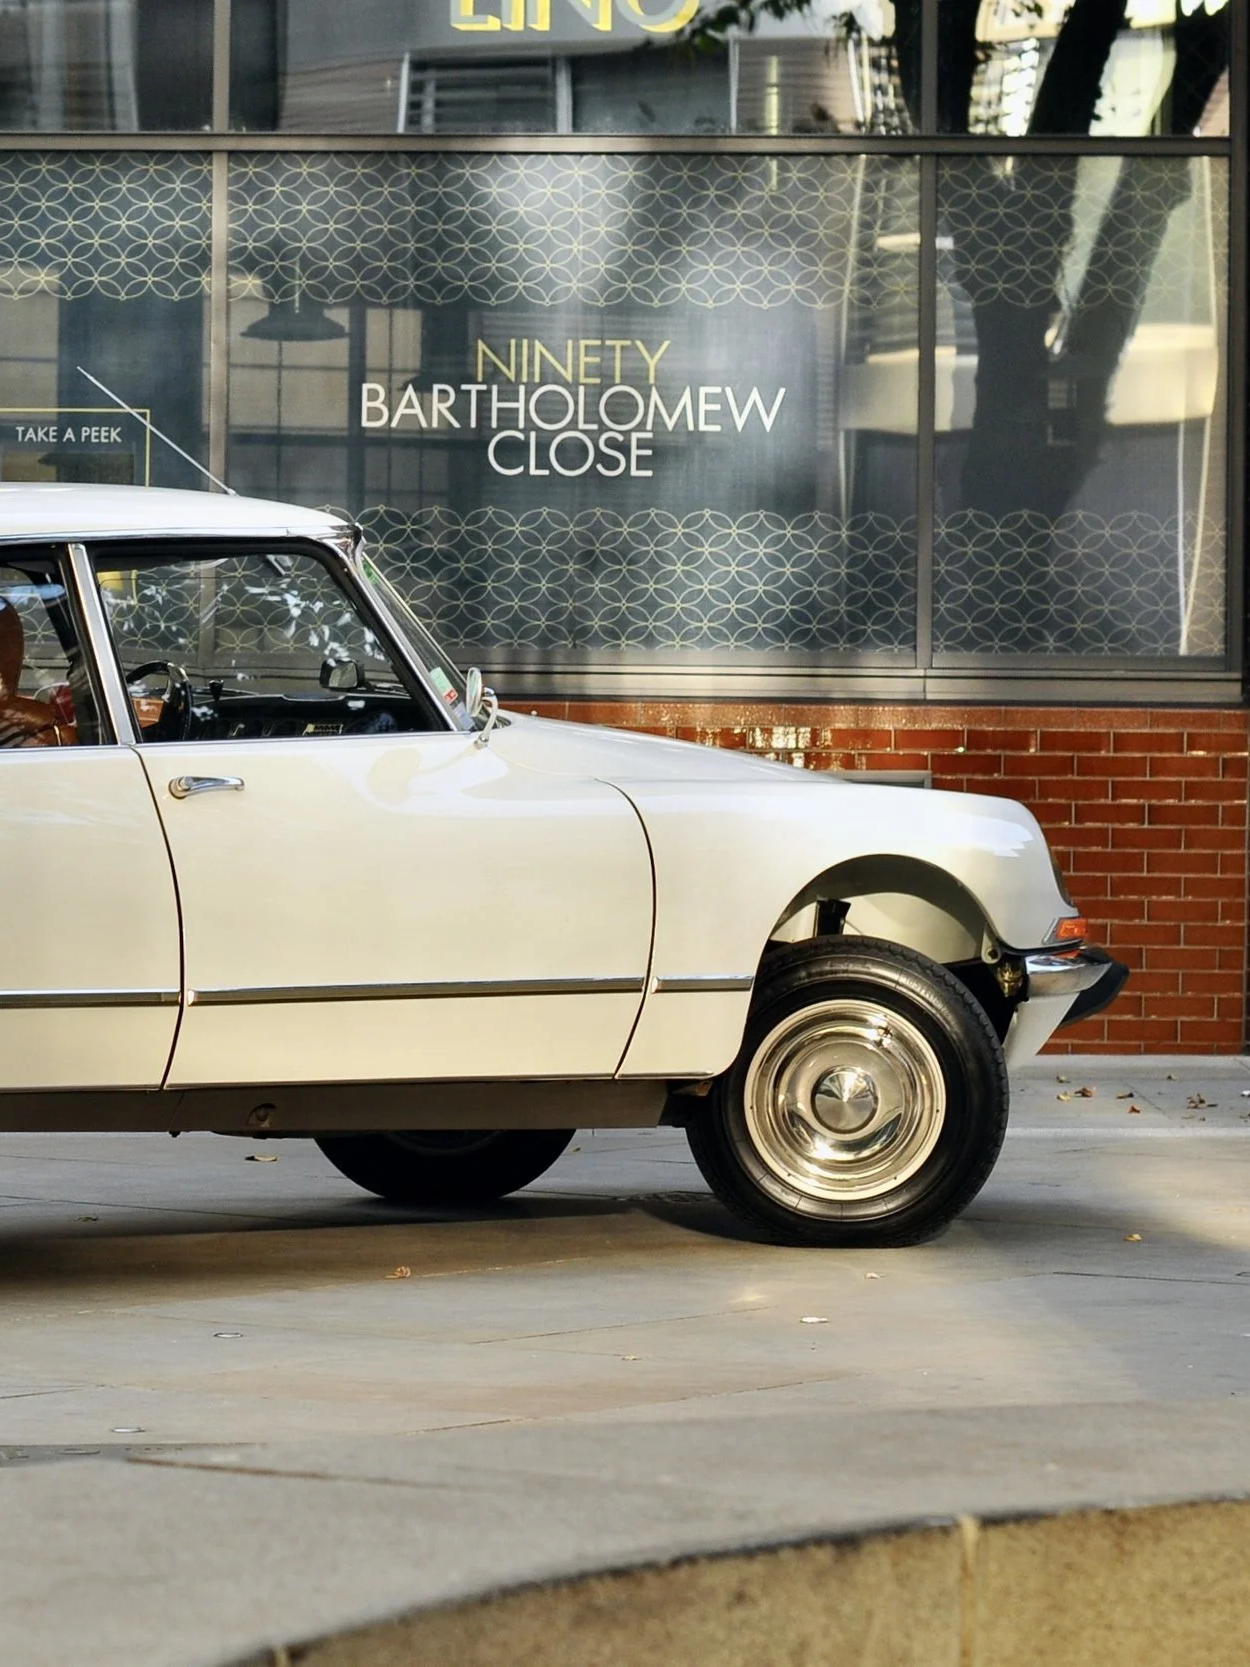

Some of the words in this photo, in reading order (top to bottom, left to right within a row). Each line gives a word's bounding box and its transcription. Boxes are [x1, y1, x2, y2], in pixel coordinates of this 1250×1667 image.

[477, 339, 671, 385] NINETY
[361, 383, 786, 432] BARTHOLOMEW
[15, 427, 58, 442] TAKE
[63, 427, 76, 442] A
[81, 427, 122, 443] PEEK
[487, 430, 654, 477] CLOSE
